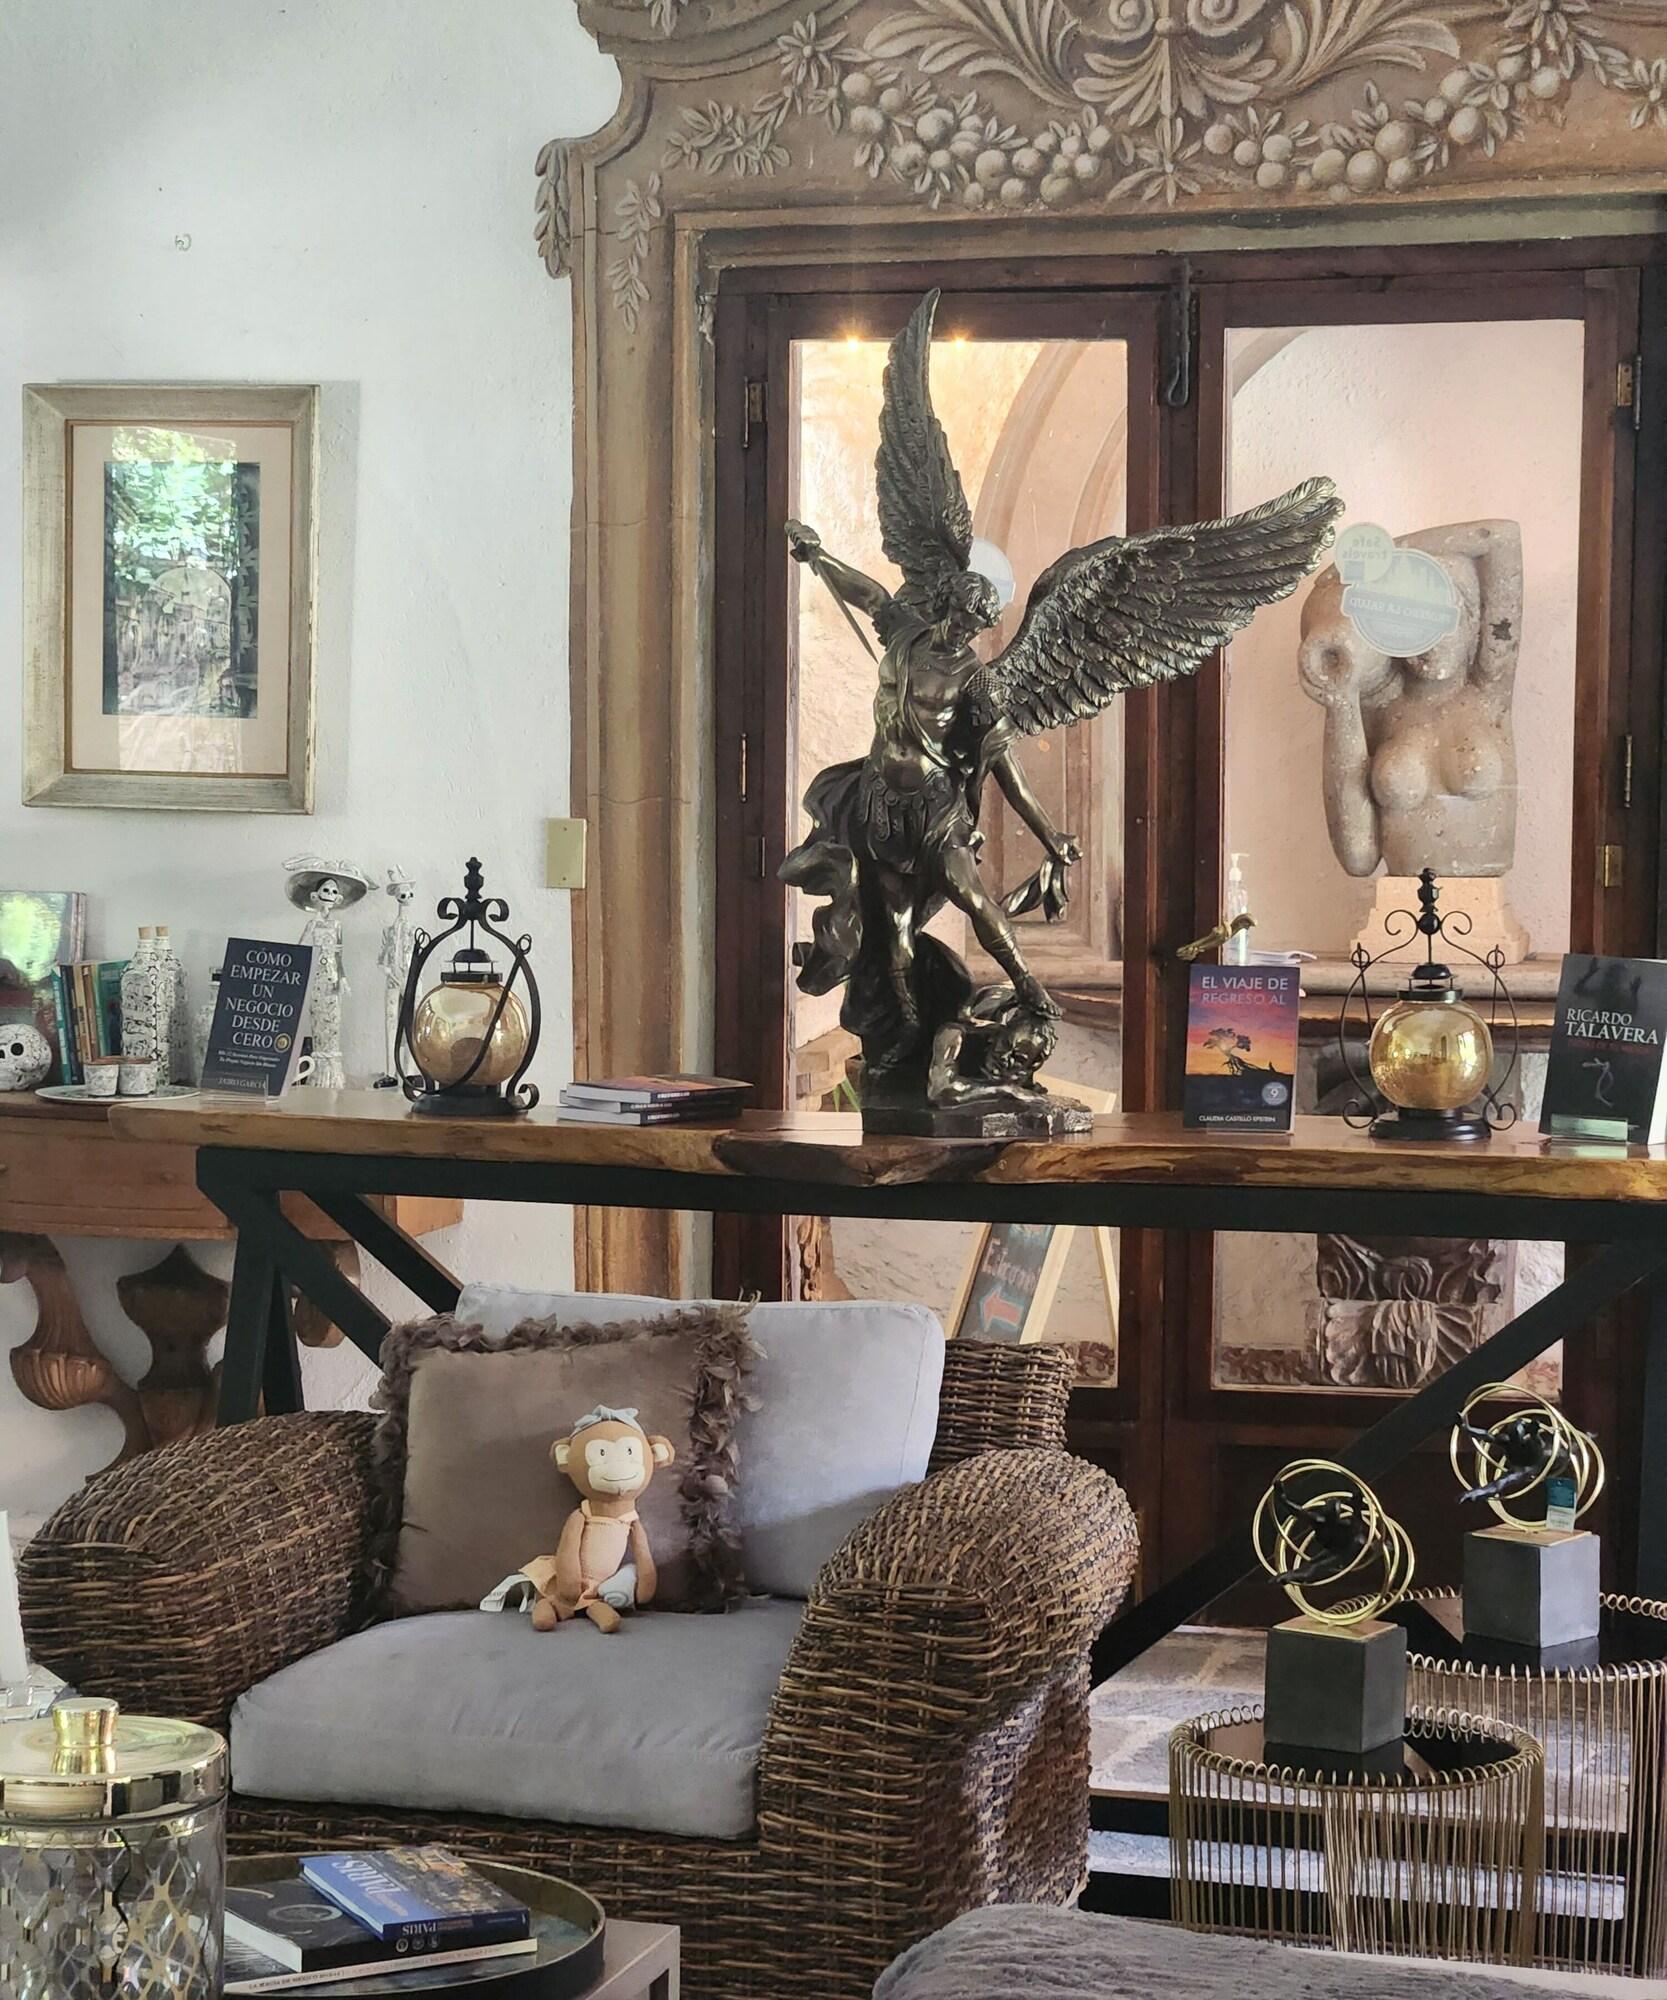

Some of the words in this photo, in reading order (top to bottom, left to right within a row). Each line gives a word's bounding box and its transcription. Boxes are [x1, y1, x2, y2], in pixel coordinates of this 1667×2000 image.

[246, 947, 292, 967] CÓMO
[230, 964, 301, 985] EMPEZAR
[1202, 976, 1218, 989] EL
[1223, 977, 1262, 990] VIAJE
[1268, 978, 1289, 991] DE
[252, 984, 275, 999] UN
[1202, 992, 1265, 1005] REGRESO
[1269, 994, 1286, 1006] AL
[225, 997, 293, 1018] NEGOCIO
[232, 1015, 281, 1033] DESDE
[1567, 1008, 1633, 1027] RICARDO
[232, 1032, 273, 1049] CERO
[1565, 1021, 1659, 1045] TALAVERA
[331, 1860, 403, 1894] PARIS
[402, 1922, 437, 1936] PARIS
